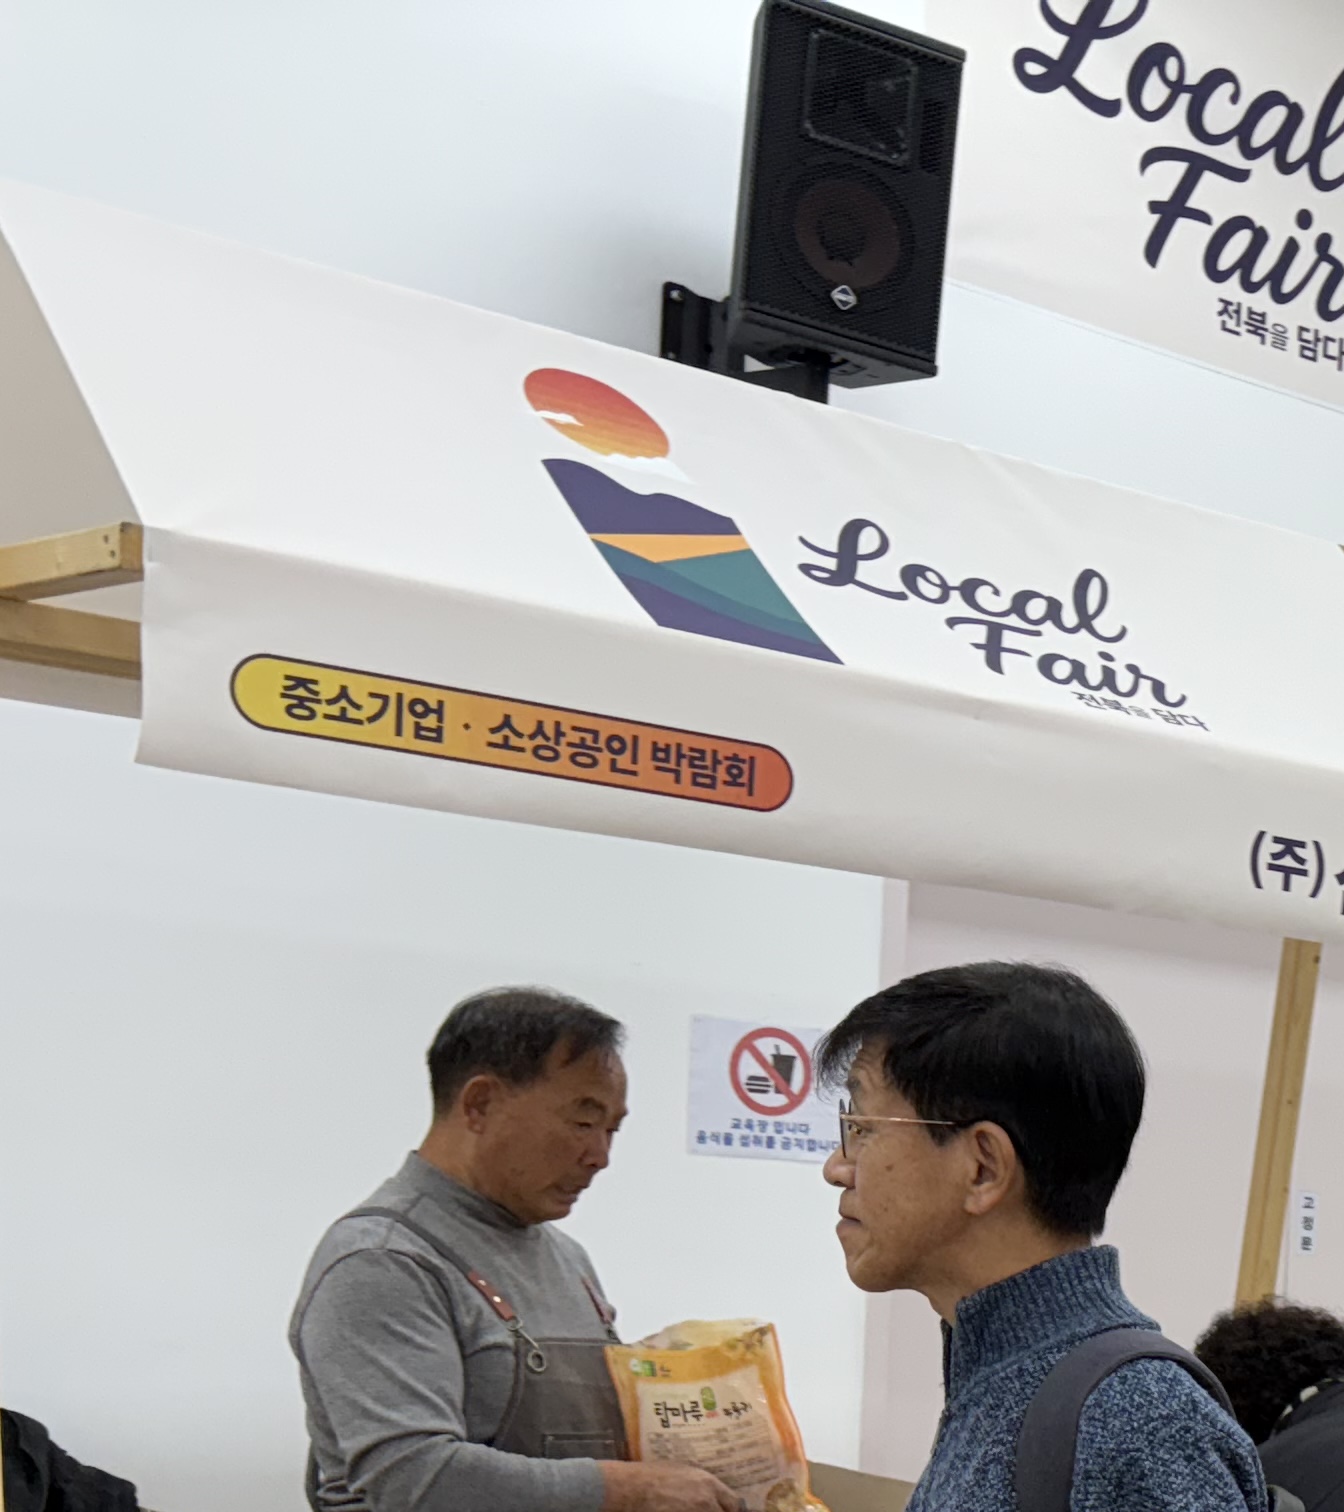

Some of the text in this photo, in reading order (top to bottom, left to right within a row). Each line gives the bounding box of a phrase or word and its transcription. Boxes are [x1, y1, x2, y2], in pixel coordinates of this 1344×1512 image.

[1216, 296, 1289, 351] 전북을
[797, 517, 1128, 643] Local
[945, 615, 1187, 709] Fair
[279, 673, 757, 798] 중소기업 소상공인 박람회
[1153, 705, 1211, 733] 담다
[1248, 829, 1325, 899] (주)
[773, 1121, 811, 1135] 입니다
